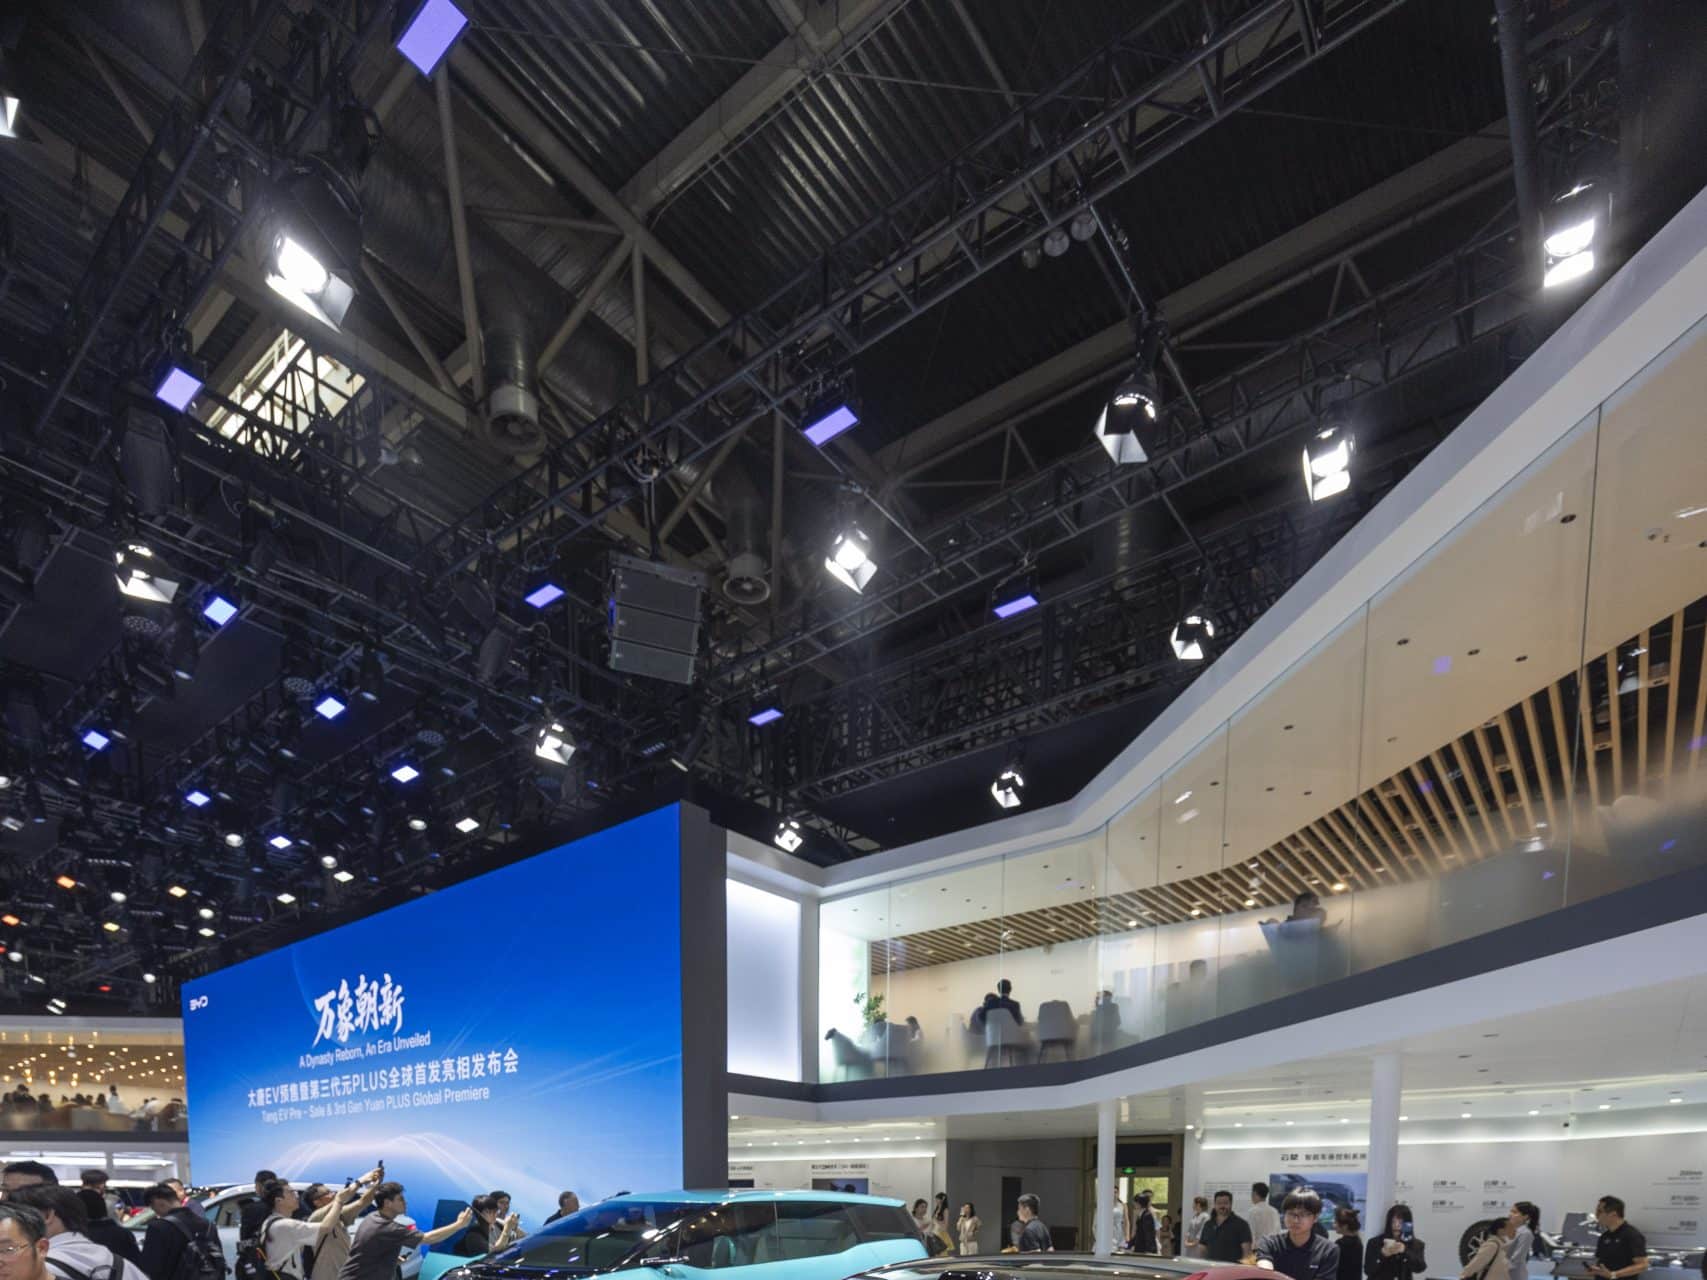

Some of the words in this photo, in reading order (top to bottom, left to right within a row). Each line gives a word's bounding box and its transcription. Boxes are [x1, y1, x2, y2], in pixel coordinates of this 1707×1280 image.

[189, 995, 209, 1011] BYD
[312, 973, 405, 1048] 万象朝新
[306, 1052, 335, 1069] Dynasty
[335, 1047, 365, 1062] Reborn,
[366, 1042, 377, 1056] An
[377, 1039, 392, 1054] Era
[393, 1030, 431, 1052] Unveiled
[278, 1107, 289, 1121] EV
[364, 1096, 385, 1112] Yuan
[386, 1094, 411, 1109] PLUS
[412, 1088, 442, 1107] Global
[444, 1086, 490, 1104] Premiere
